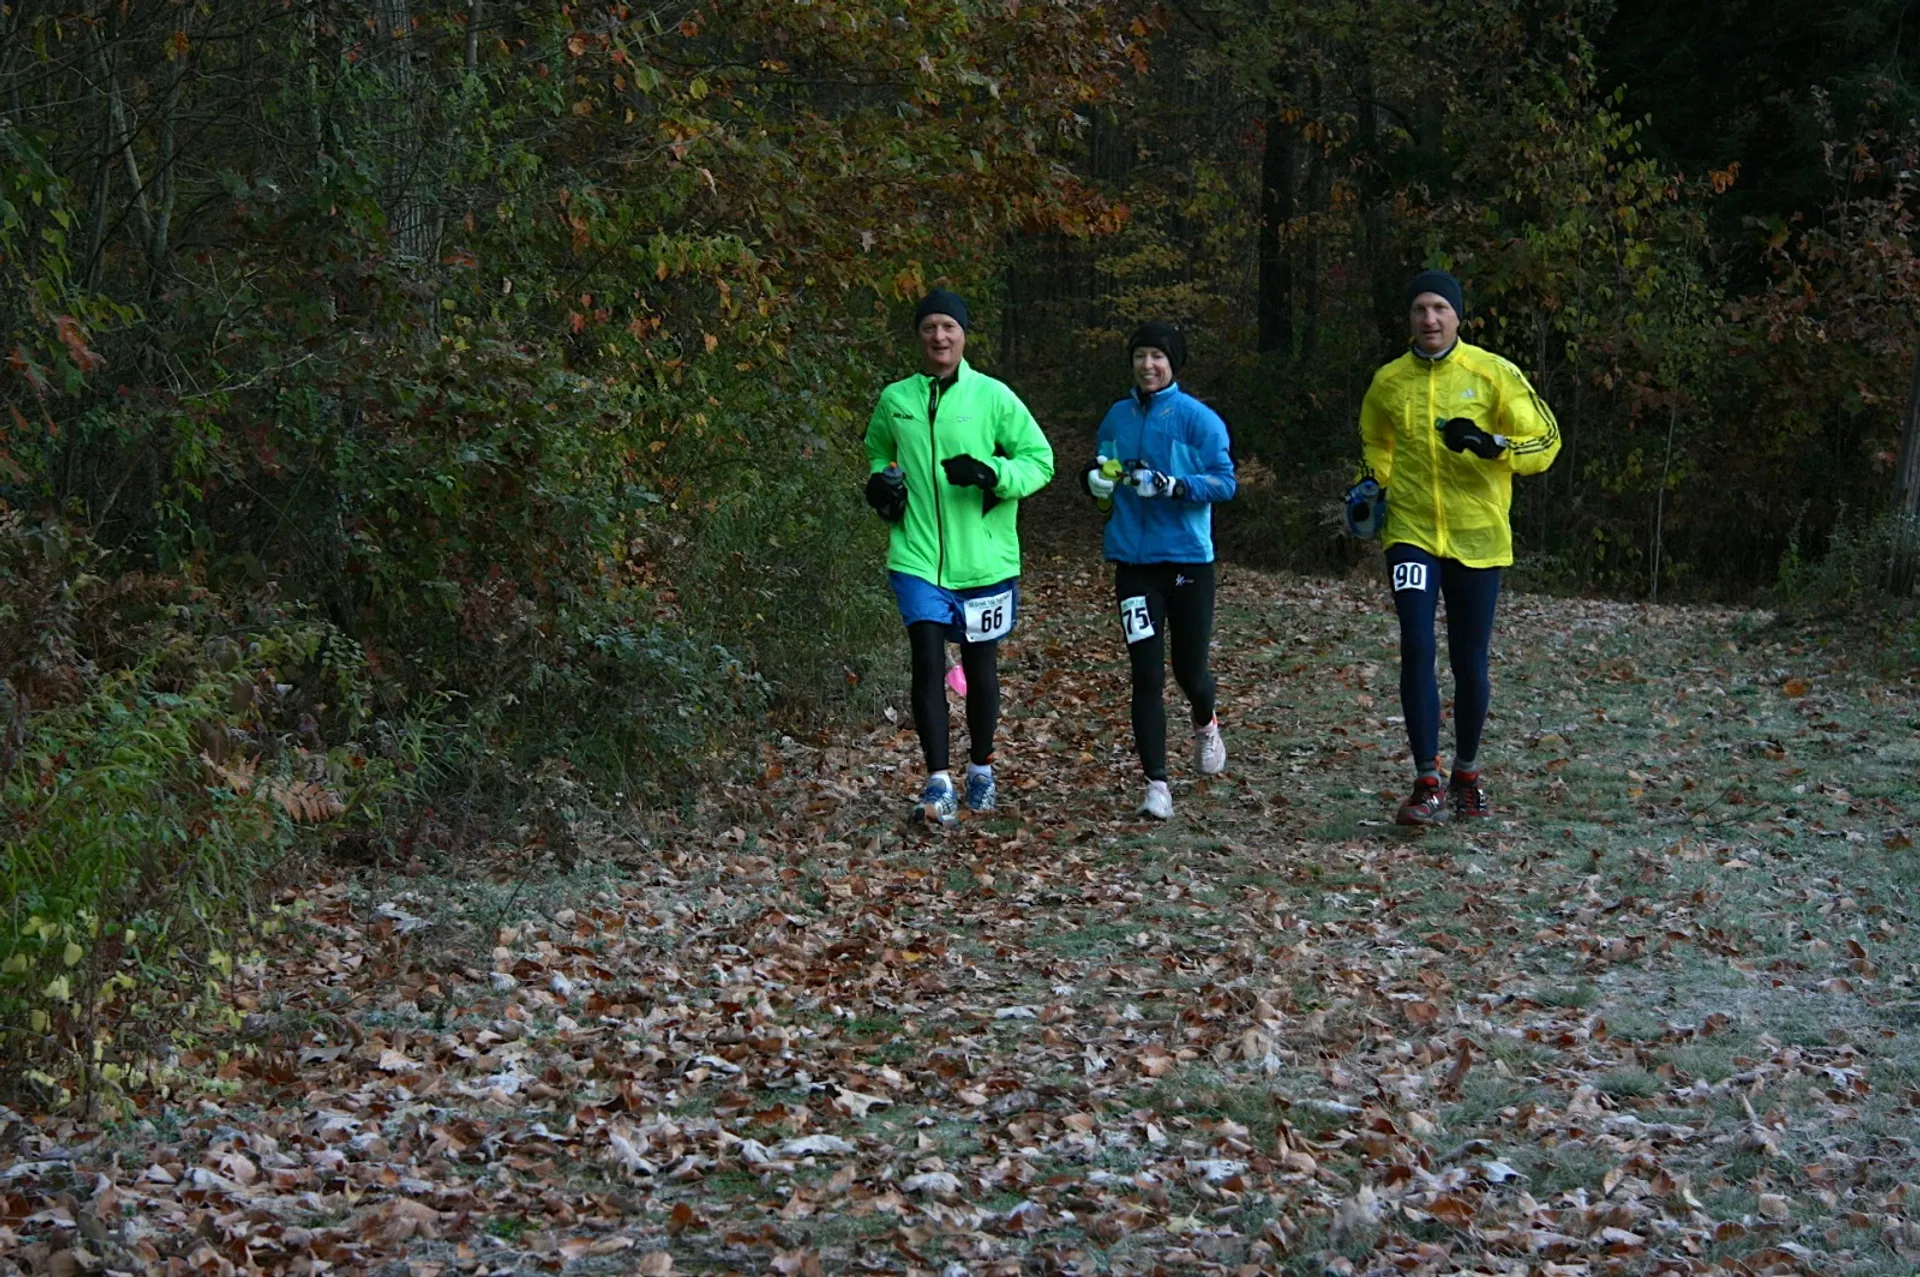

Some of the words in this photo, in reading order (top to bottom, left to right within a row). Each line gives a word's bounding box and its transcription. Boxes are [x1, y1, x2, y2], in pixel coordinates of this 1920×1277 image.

[1396, 564, 1422, 588] 90
[981, 605, 1002, 633] 66
[1122, 607, 1149, 635] 75
